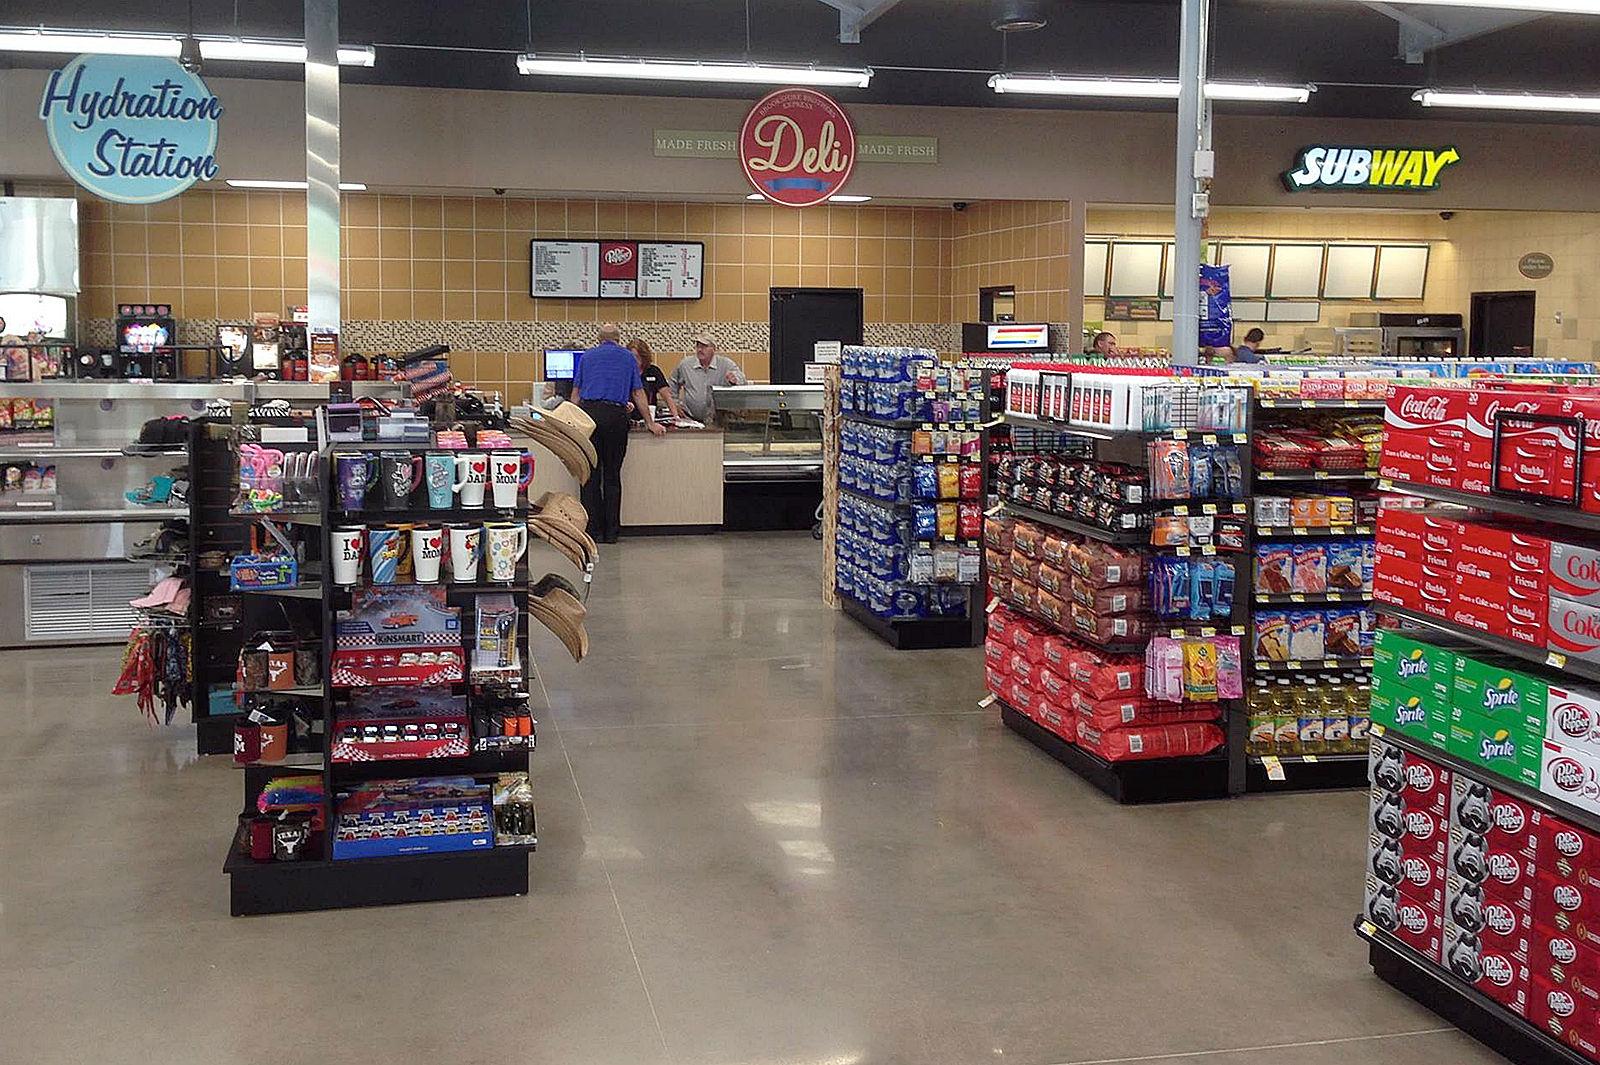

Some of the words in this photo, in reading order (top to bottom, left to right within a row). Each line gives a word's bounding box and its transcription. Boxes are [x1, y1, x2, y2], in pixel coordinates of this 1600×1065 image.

[42, 65, 223, 129] Hydration
[656, 138, 693, 150] MADE
[696, 139, 737, 151] FRESH
[749, 114, 848, 173] Deli
[87, 128, 219, 179] Station
[858, 145, 894, 156] MADE
[897, 145, 935, 157] FRESH
[1290, 146, 1461, 187] SUBWAY
[1401, 394, 1450, 421] Coca-Cola
[496, 462, 503, 475] I
[496, 475, 517, 484] MOM
[343, 539, 350, 551] I
[422, 538, 430, 550] I
[343, 551, 358, 560] DA
[1427, 554, 1448, 567] Friend
[1567, 555, 1600, 584] Cok
[1514, 575, 1538, 589] Friend
[377, 633, 422, 644] KINSMART
[1511, 628, 1535, 642] Friend
[1397, 657, 1428, 678] Sprite
[1483, 687, 1519, 710] Sprite
[1395, 705, 1425, 725] Sprite
[1571, 708, 1583, 718] Dr
[1562, 709, 1590, 733] Pepper
[1479, 738, 1515, 761] Sprite
[1417, 766, 1427, 775] Dr
[1556, 763, 1584, 786] Pepper
[1566, 763, 1577, 773] Dr
[1408, 765, 1431, 787] Pepper
[1416, 812, 1427, 822] Dr
[1494, 804, 1523, 829] Pepper
[1505, 805, 1516, 816] Dr
[1407, 812, 1431, 834] Pepper
[1413, 859, 1423, 869] Dr
[1490, 855, 1517, 878] Pepper
[1500, 855, 1511, 867] Dr
[1404, 858, 1429, 882] Pepper
[1401, 906, 1426, 929] Pepper
[1410, 906, 1420, 917] Dr
[1486, 905, 1513, 932] Pepper
[1497, 907, 1507, 918] Dr
[1483, 956, 1510, 980] Pepper
[1494, 957, 1504, 968] Dr
